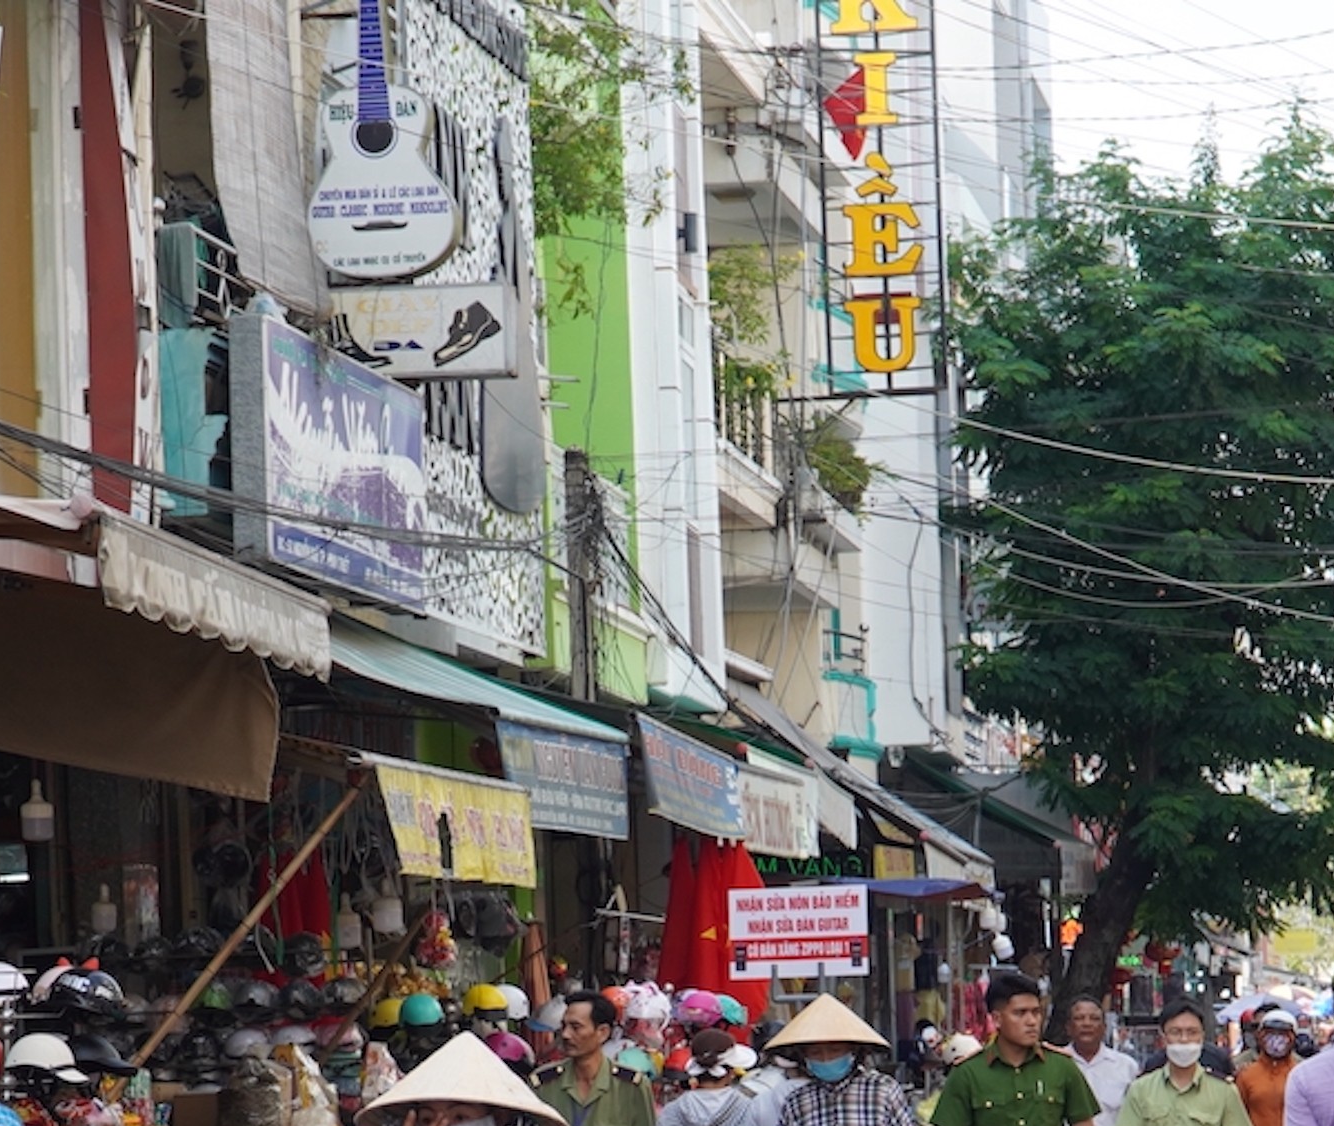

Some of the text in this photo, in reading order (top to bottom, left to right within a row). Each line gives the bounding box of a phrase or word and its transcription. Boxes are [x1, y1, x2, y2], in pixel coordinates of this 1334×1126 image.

[736, 889, 859, 915] NHẬN SỬA NÓN BẢO HIỂM
[748, 918, 773, 937] NHẬN
[776, 915, 794, 933] SỬA
[818, 917, 849, 932] GUITAR
